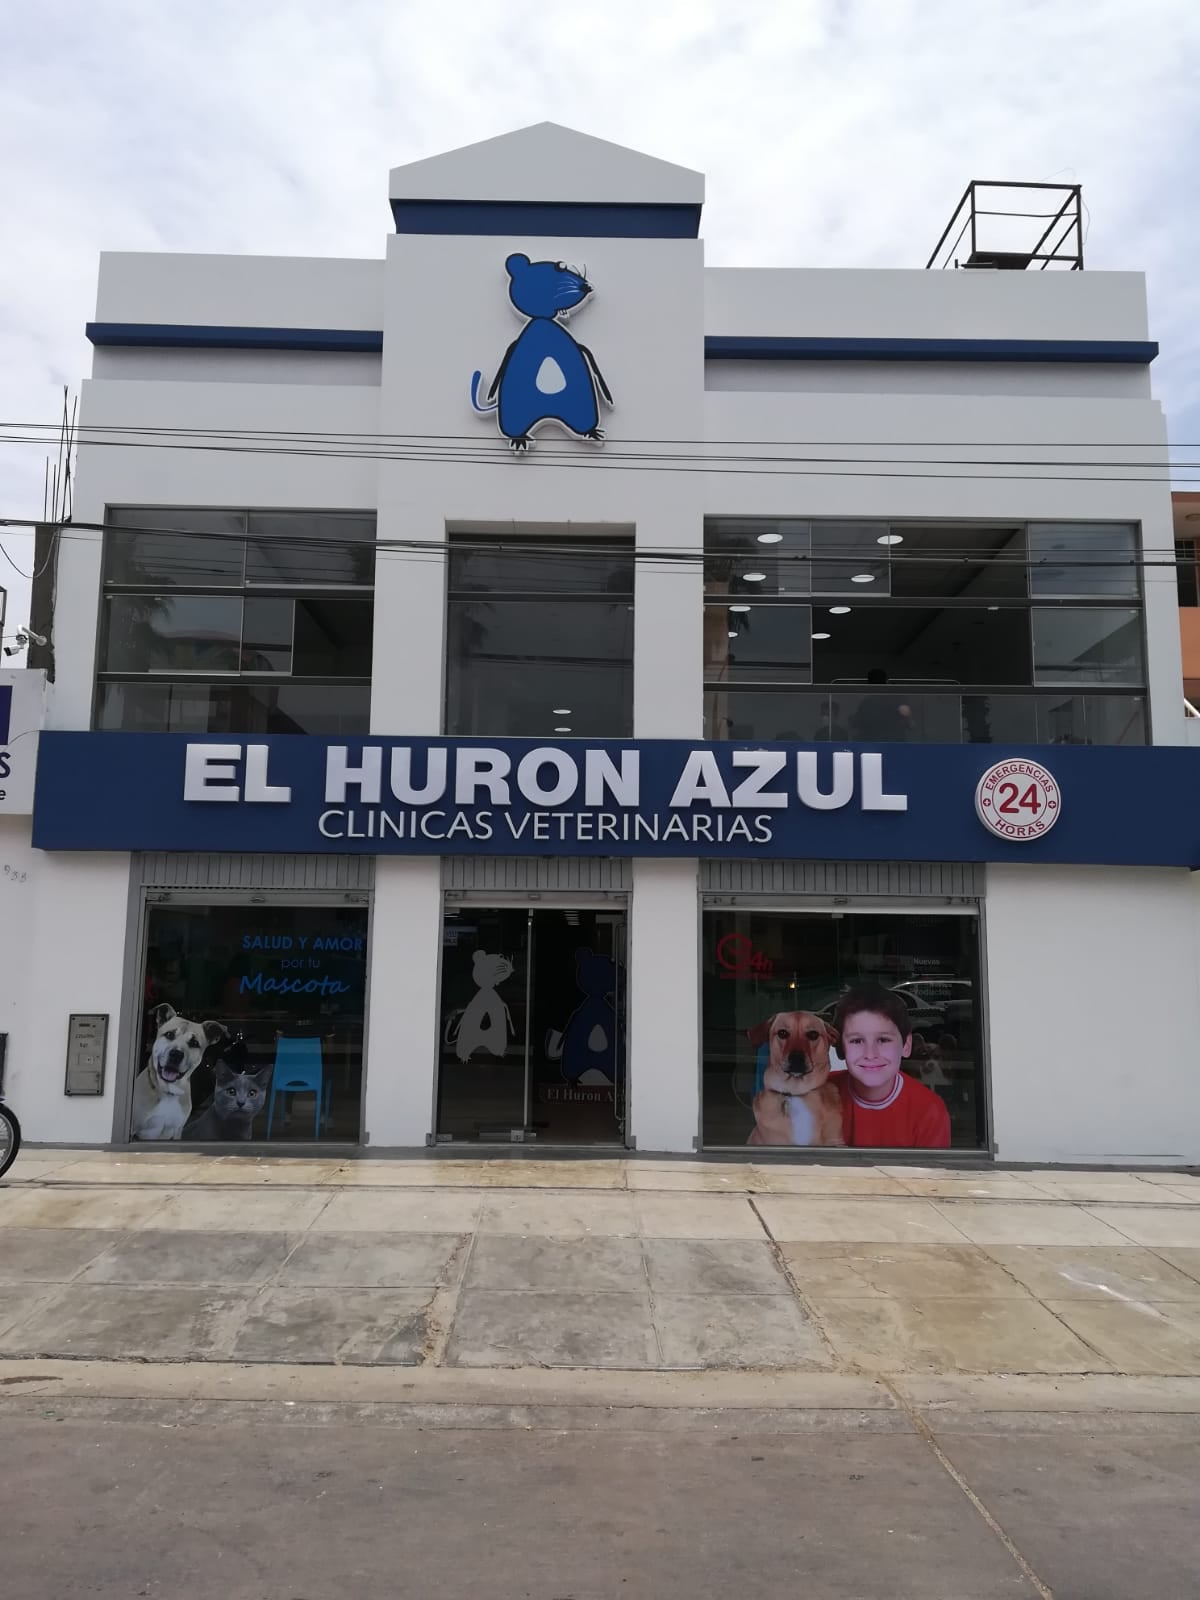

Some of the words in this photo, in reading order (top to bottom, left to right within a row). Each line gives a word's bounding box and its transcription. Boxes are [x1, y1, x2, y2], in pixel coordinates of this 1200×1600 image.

[184, 744, 292, 803] EL
[325, 745, 640, 807] HURON
[669, 750, 908, 811] AZUL
[985, 764, 1054, 793] EMERGENCIAS
[998, 782, 1042, 815] 24
[318, 809, 494, 840] CLINICAS
[504, 811, 774, 844] VETERINARIAS
[995, 820, 1046, 836] HORAS
[242, 935, 293, 950] SALUD
[298, 936, 308, 950] Y
[312, 936, 363, 951] AMOR
[281, 958, 304, 970] por
[308, 957, 320, 969] tu
[239, 972, 351, 996] Mascota
[547, 1087, 560, 1101] El
[563, 1087, 601, 1103] Huron
